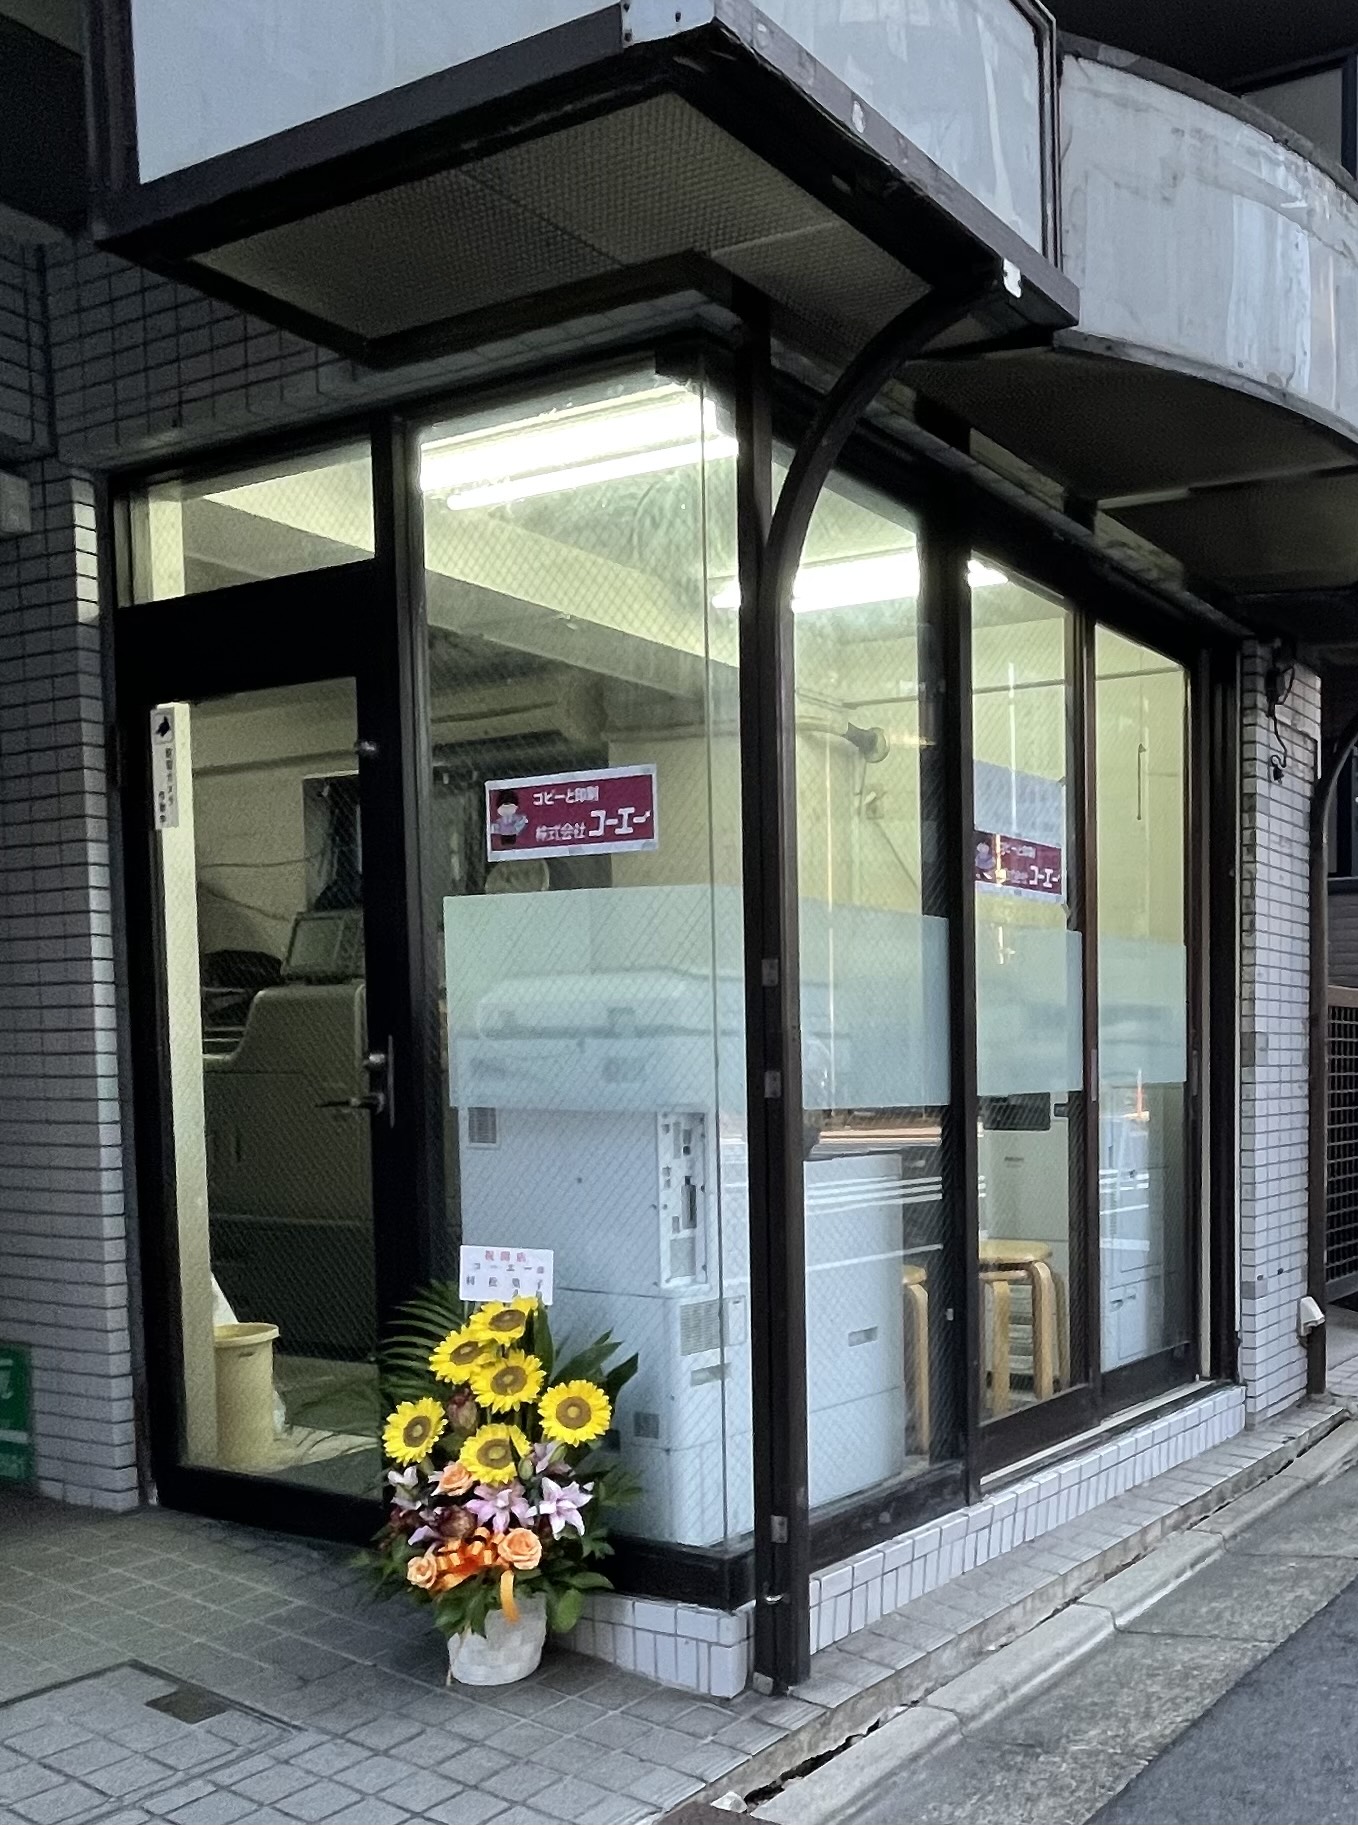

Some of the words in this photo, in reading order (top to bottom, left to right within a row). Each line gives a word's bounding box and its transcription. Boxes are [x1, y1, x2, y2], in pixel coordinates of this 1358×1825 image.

[533, 785, 600, 806] コピーと印刷
